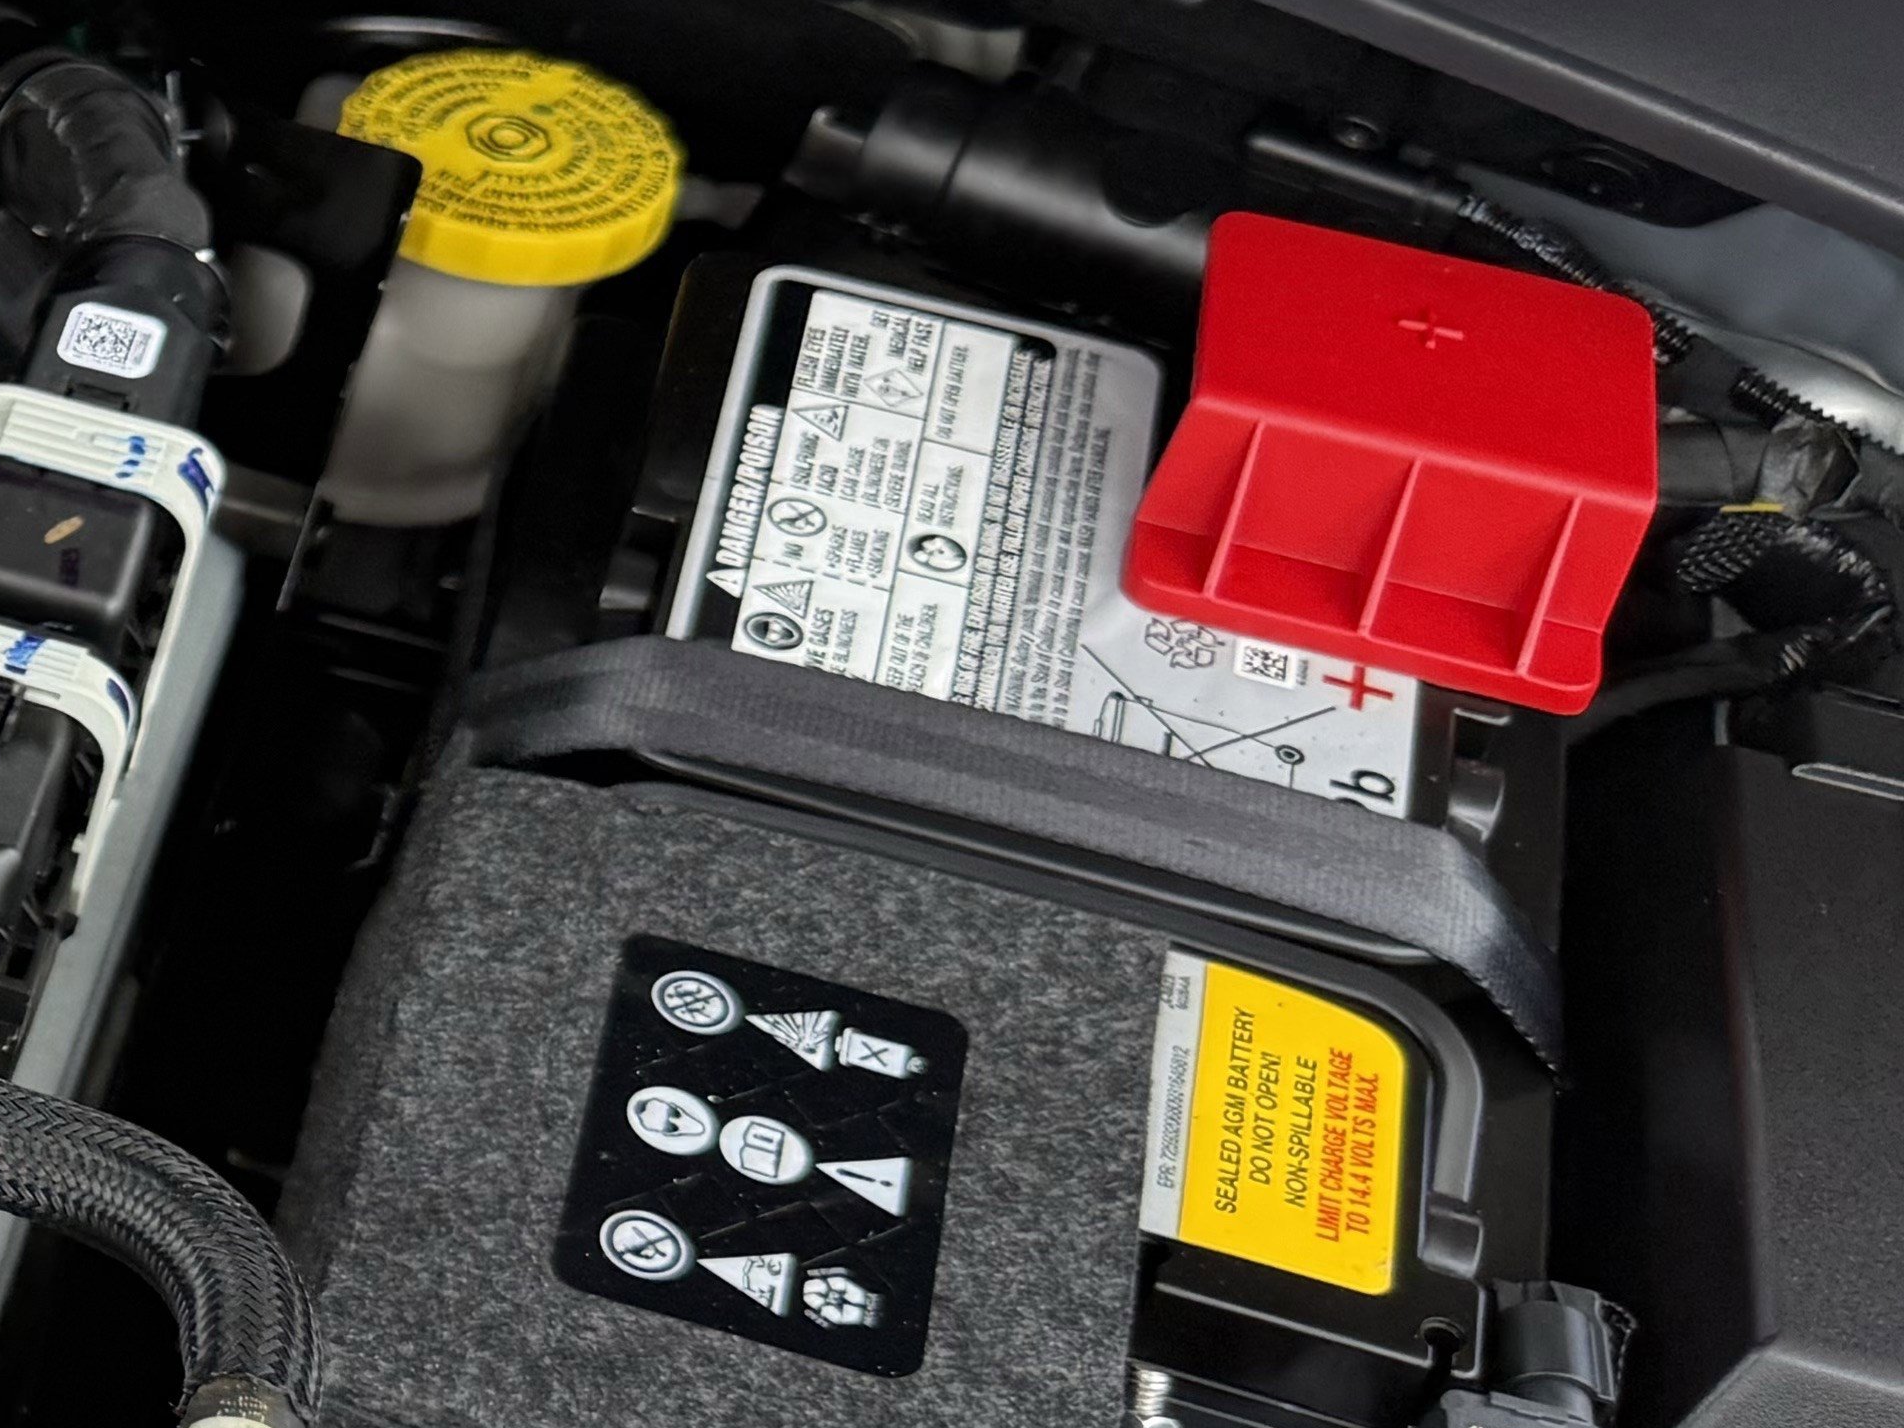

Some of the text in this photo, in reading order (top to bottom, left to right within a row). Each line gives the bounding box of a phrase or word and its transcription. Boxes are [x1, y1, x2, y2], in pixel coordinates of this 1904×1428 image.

[1214, 1005, 1254, 1215] SEALED AGM BATTERY
[1249, 1050, 1281, 1185] DO NOT OPEN!
[1284, 1054, 1316, 1208] NON-SPILLABLE
[1315, 1046, 1352, 1242] LIMIT CHARGE VOLTAGE
[1345, 1068, 1378, 1235] TO 14.4 VOLTS MAX.
